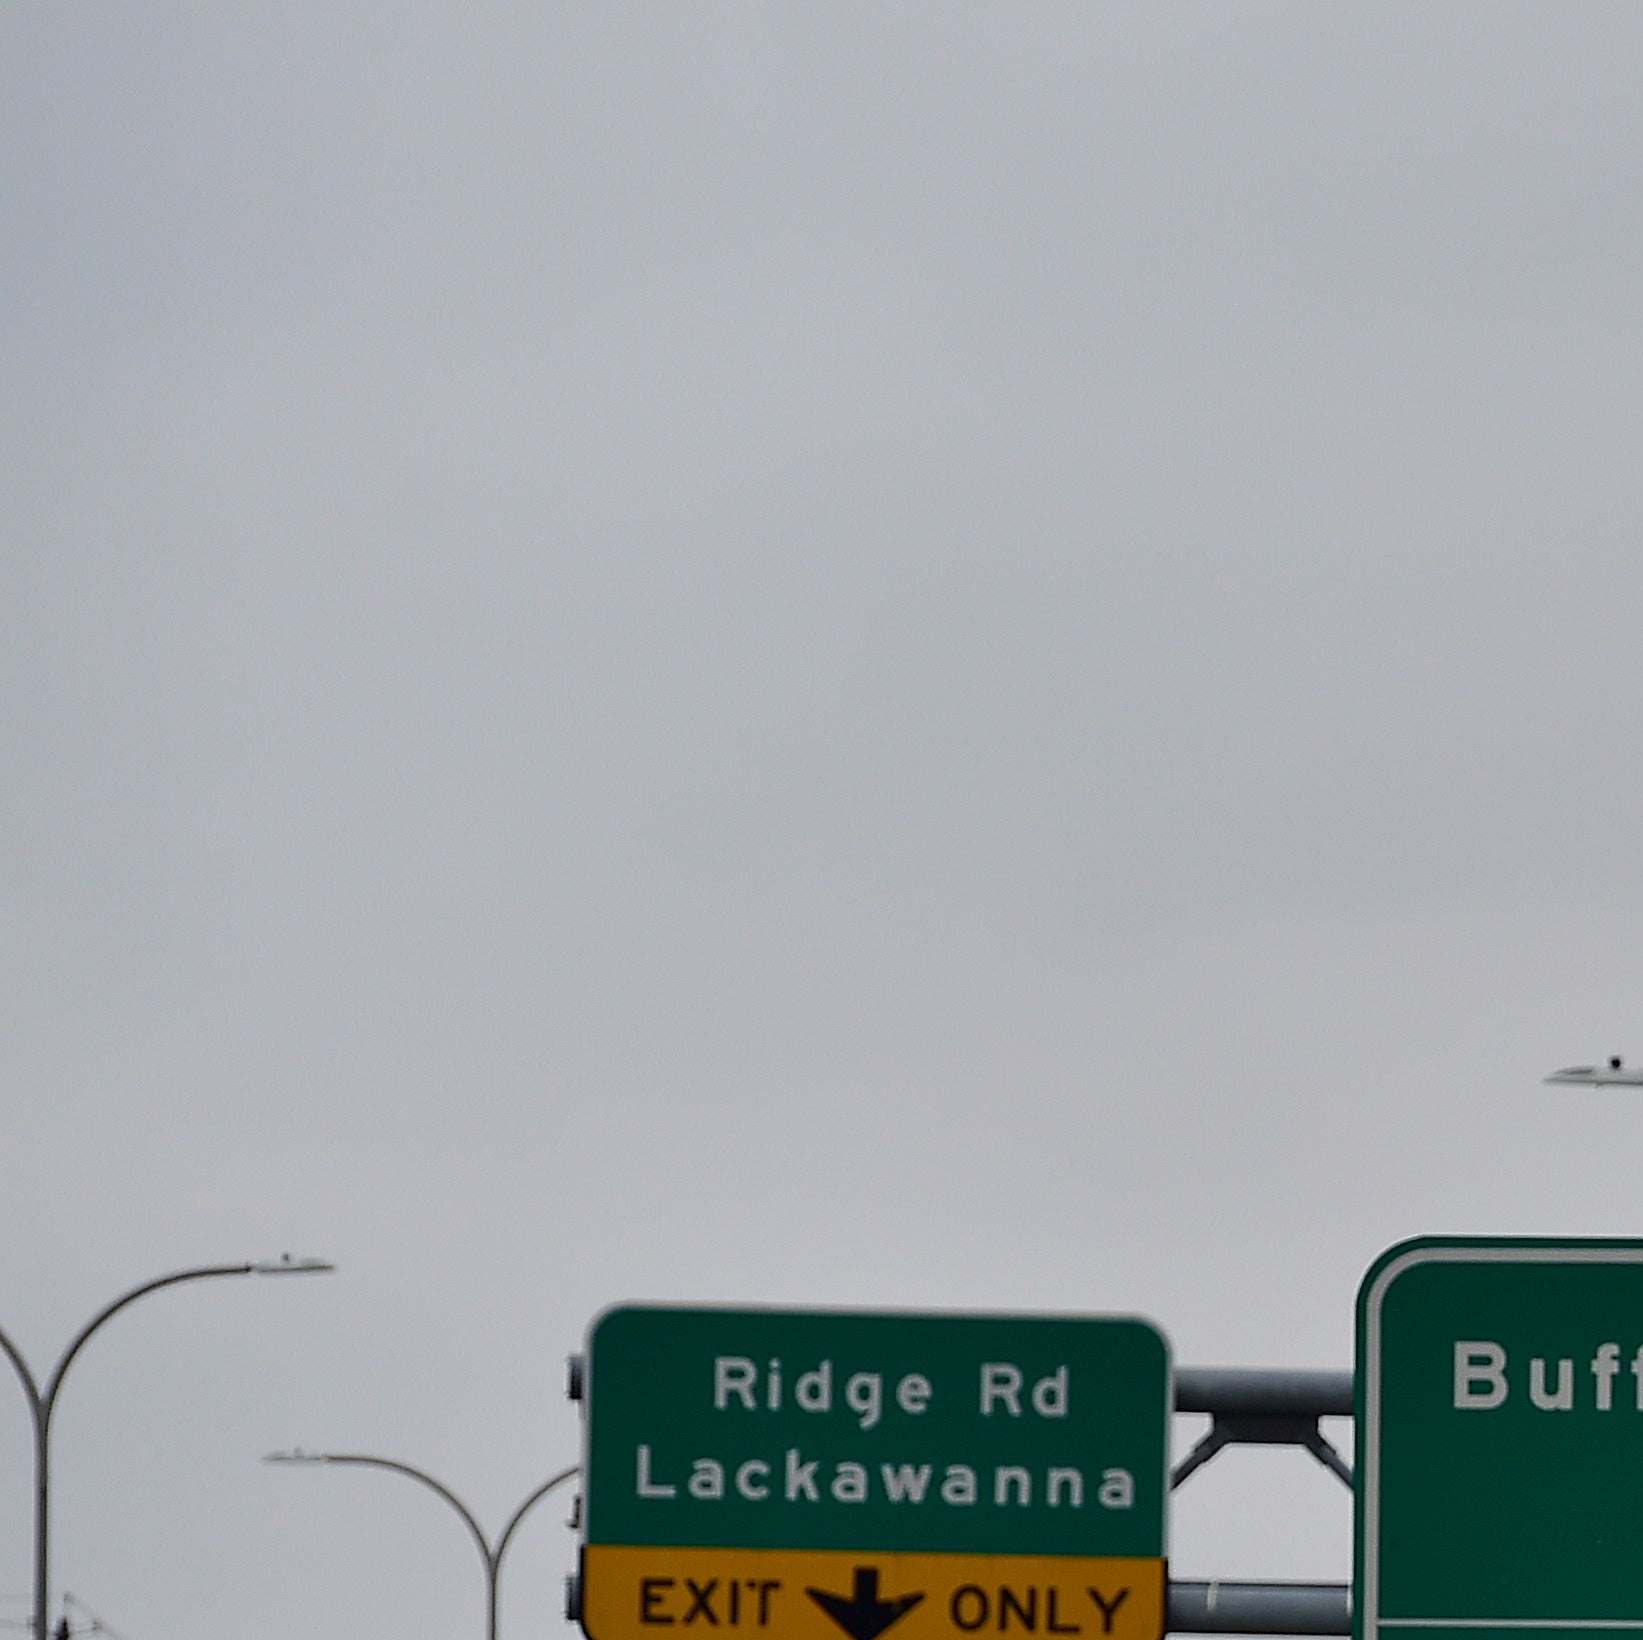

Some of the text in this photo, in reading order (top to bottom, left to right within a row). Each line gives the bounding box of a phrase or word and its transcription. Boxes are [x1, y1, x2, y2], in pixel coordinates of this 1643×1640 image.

[714, 1357, 1068, 1429] Ridge Rd
[636, 1444, 1134, 1508] Lackawanna
[639, 1577, 1130, 1635] EXIT ONLY
